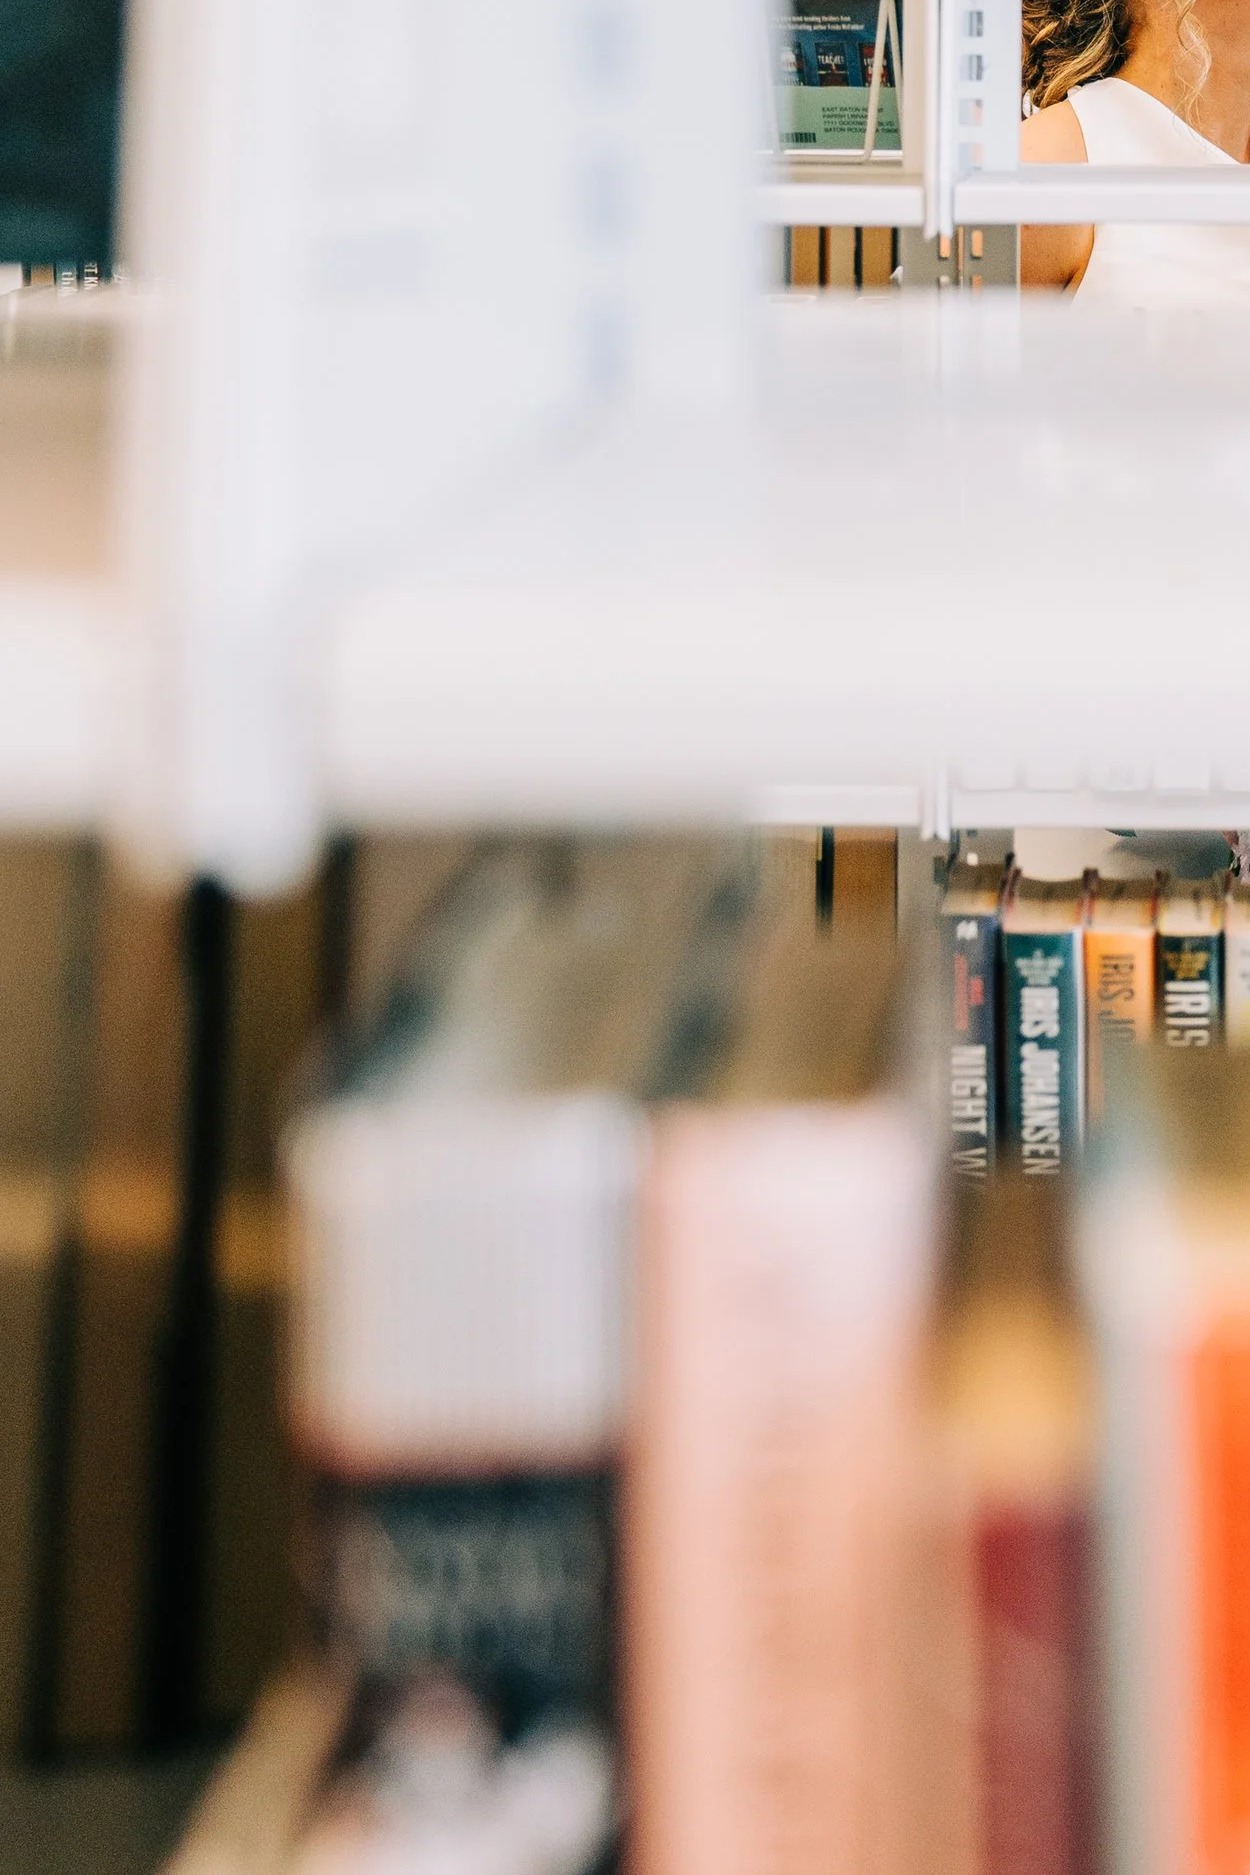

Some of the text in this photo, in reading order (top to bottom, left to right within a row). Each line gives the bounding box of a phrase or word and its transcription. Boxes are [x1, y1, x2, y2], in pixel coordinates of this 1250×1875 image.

[1098, 954, 1136, 1002] IRIS
[1165, 980, 1210, 1048] IRIS
[951, 1044, 987, 1136] NIGHT
[1020, 986, 1061, 1175] IRIS JOHANSEN
